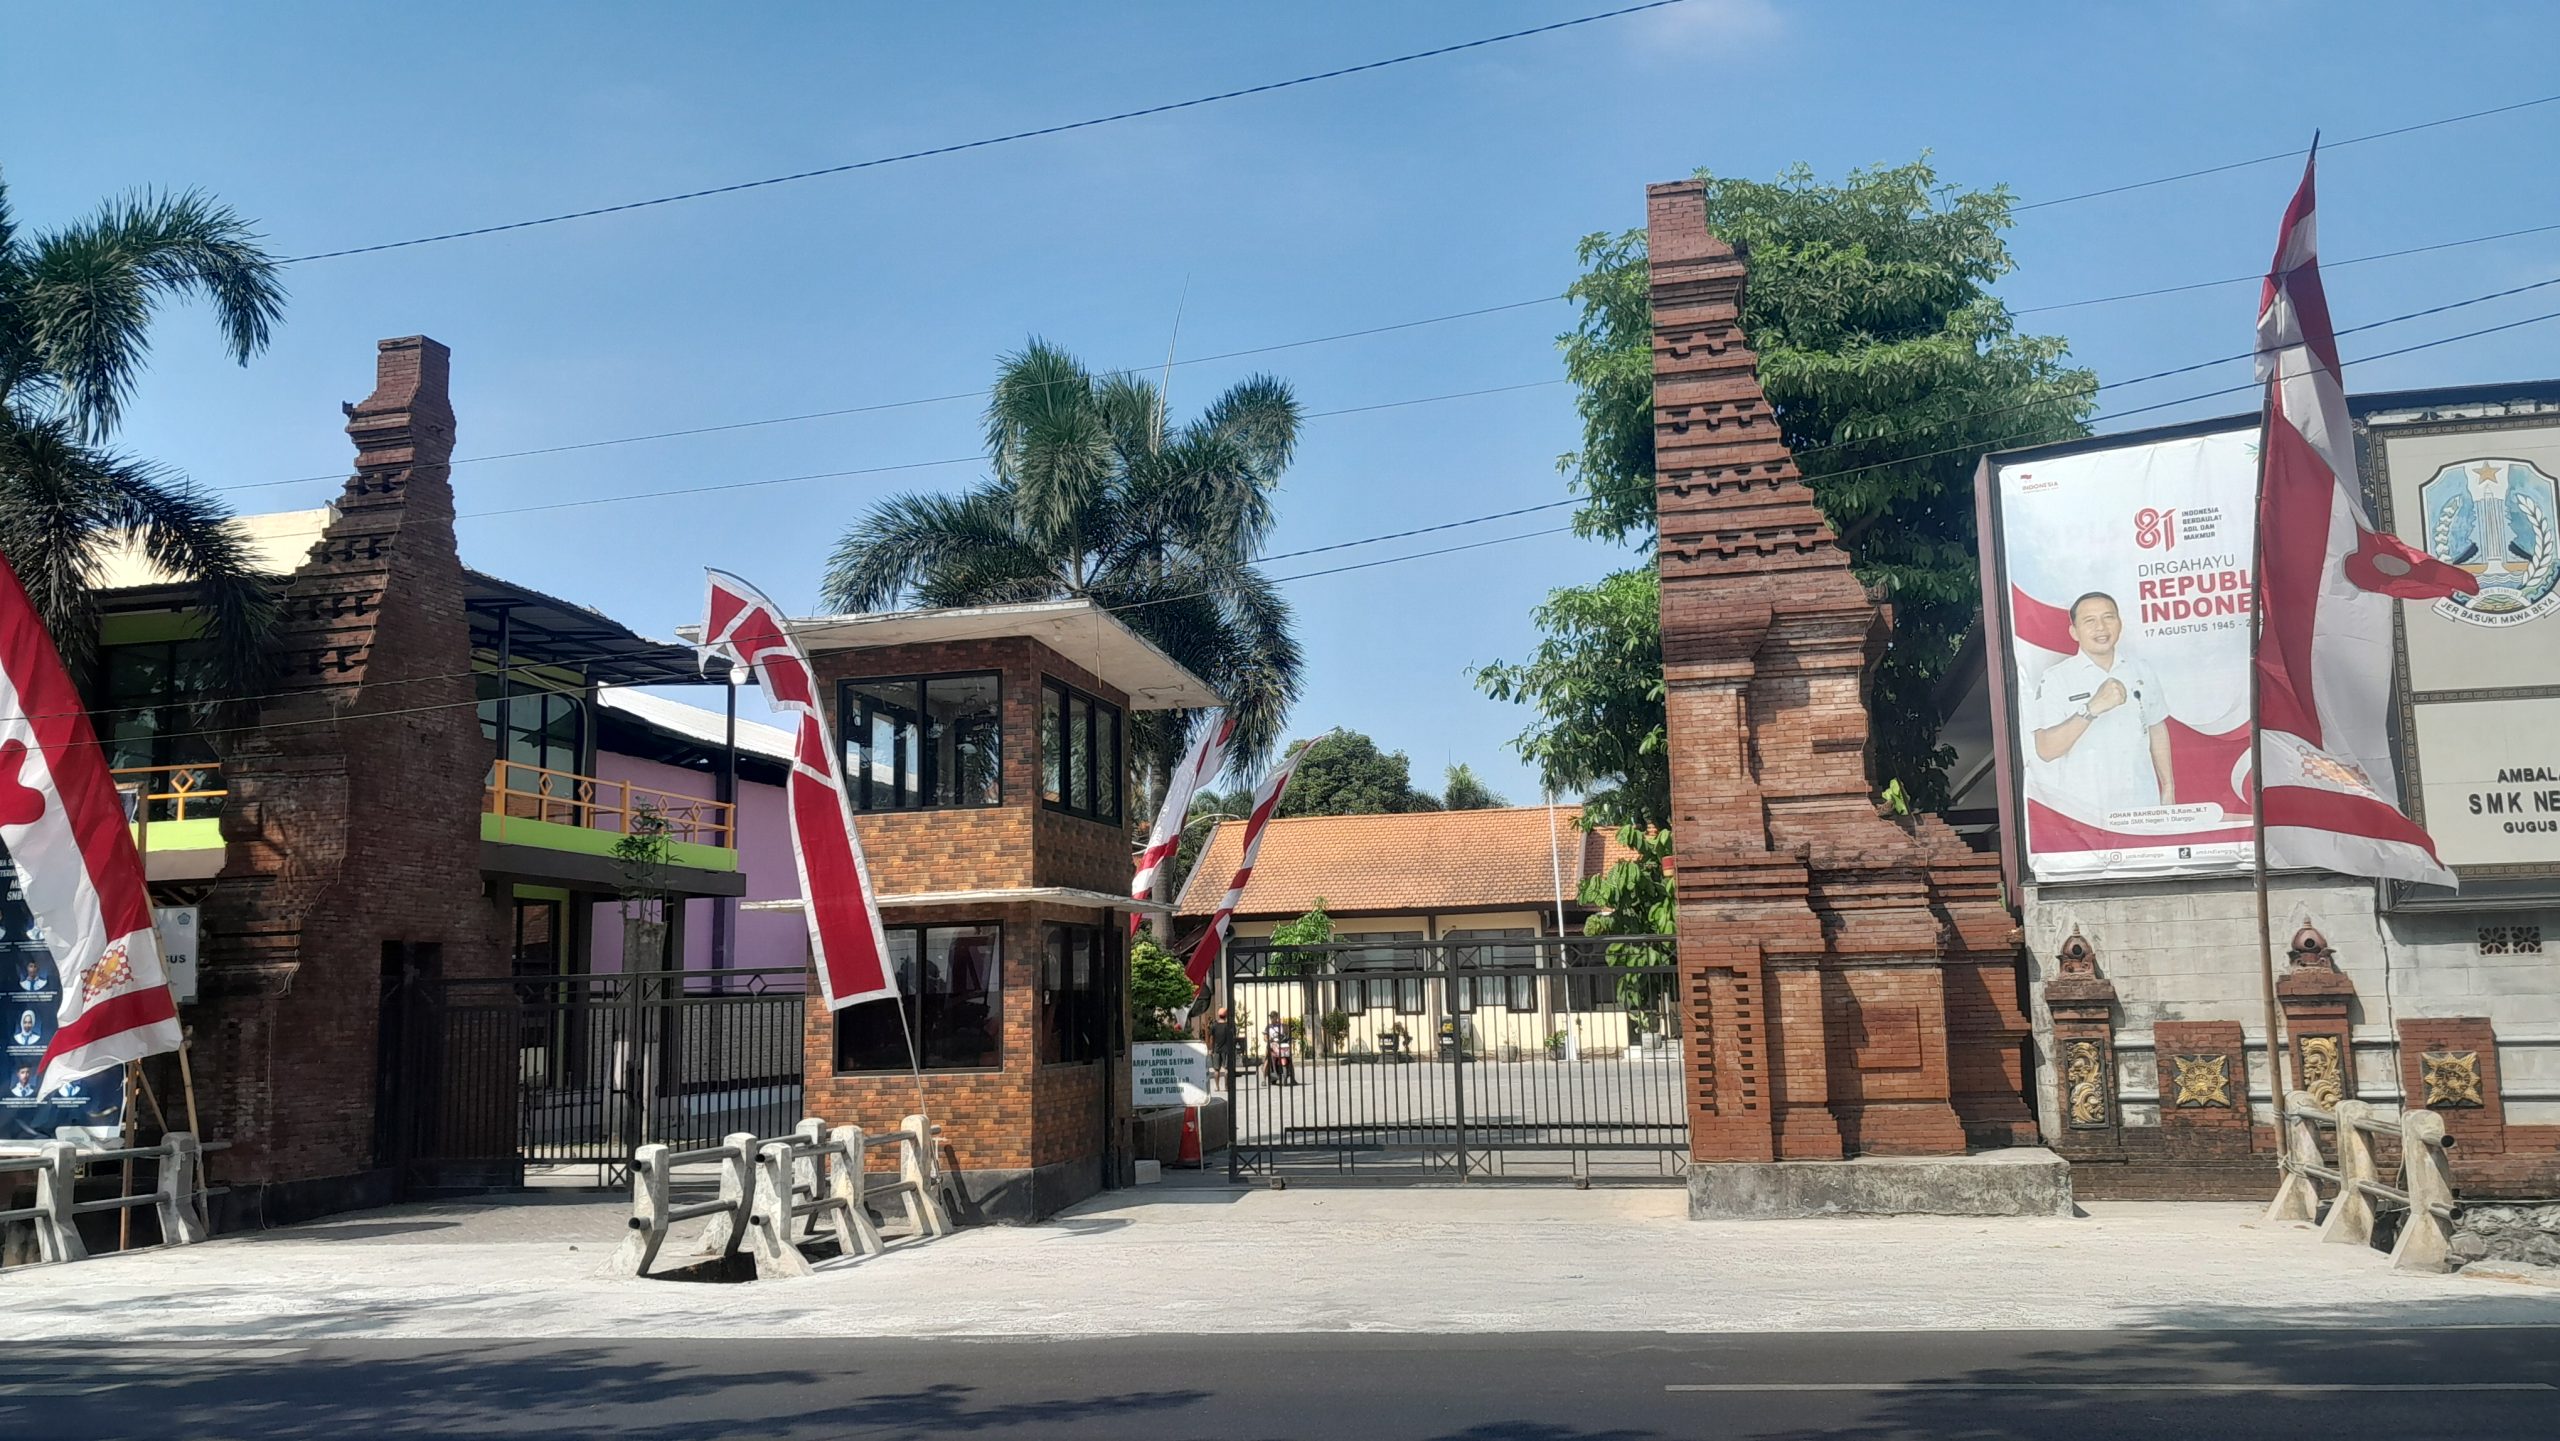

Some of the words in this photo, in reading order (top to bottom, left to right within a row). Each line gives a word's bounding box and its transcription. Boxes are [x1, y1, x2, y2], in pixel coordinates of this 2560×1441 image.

[2181, 507, 2219, 517] INDONESIA
[2182, 514, 2223, 525] BERDAULAT
[2133, 508, 2177, 552] 81
[2183, 524, 2199, 533] ADIL
[2184, 531, 2216, 541] MAKMUR
[2138, 553, 2235, 577] DIRGAHAYU
[2138, 569, 2252, 601] REPUBL
[2141, 592, 2253, 624] INDONE
[2440, 600, 2460, 615] JER
[2460, 609, 2497, 625] BASUKI
[2500, 612, 2531, 625] MAWA
[2532, 598, 2555, 614] BEYA
[2144, 629, 2155, 638] 17
[2158, 623, 2208, 636] AGUSTUS
[2212, 620, 2236, 631] 1945
[2497, 766, 2560, 783] AMBAL
[2468, 791, 2523, 815] SMK
[2109, 811, 2131, 819] JOHAN
[2503, 820, 2558, 834] GUGUS
[1151, 1047, 1173, 1057] TAMU
[1151, 1067, 1175, 1077] SISWA
[1143, 1086, 1164, 1095] HARAP
